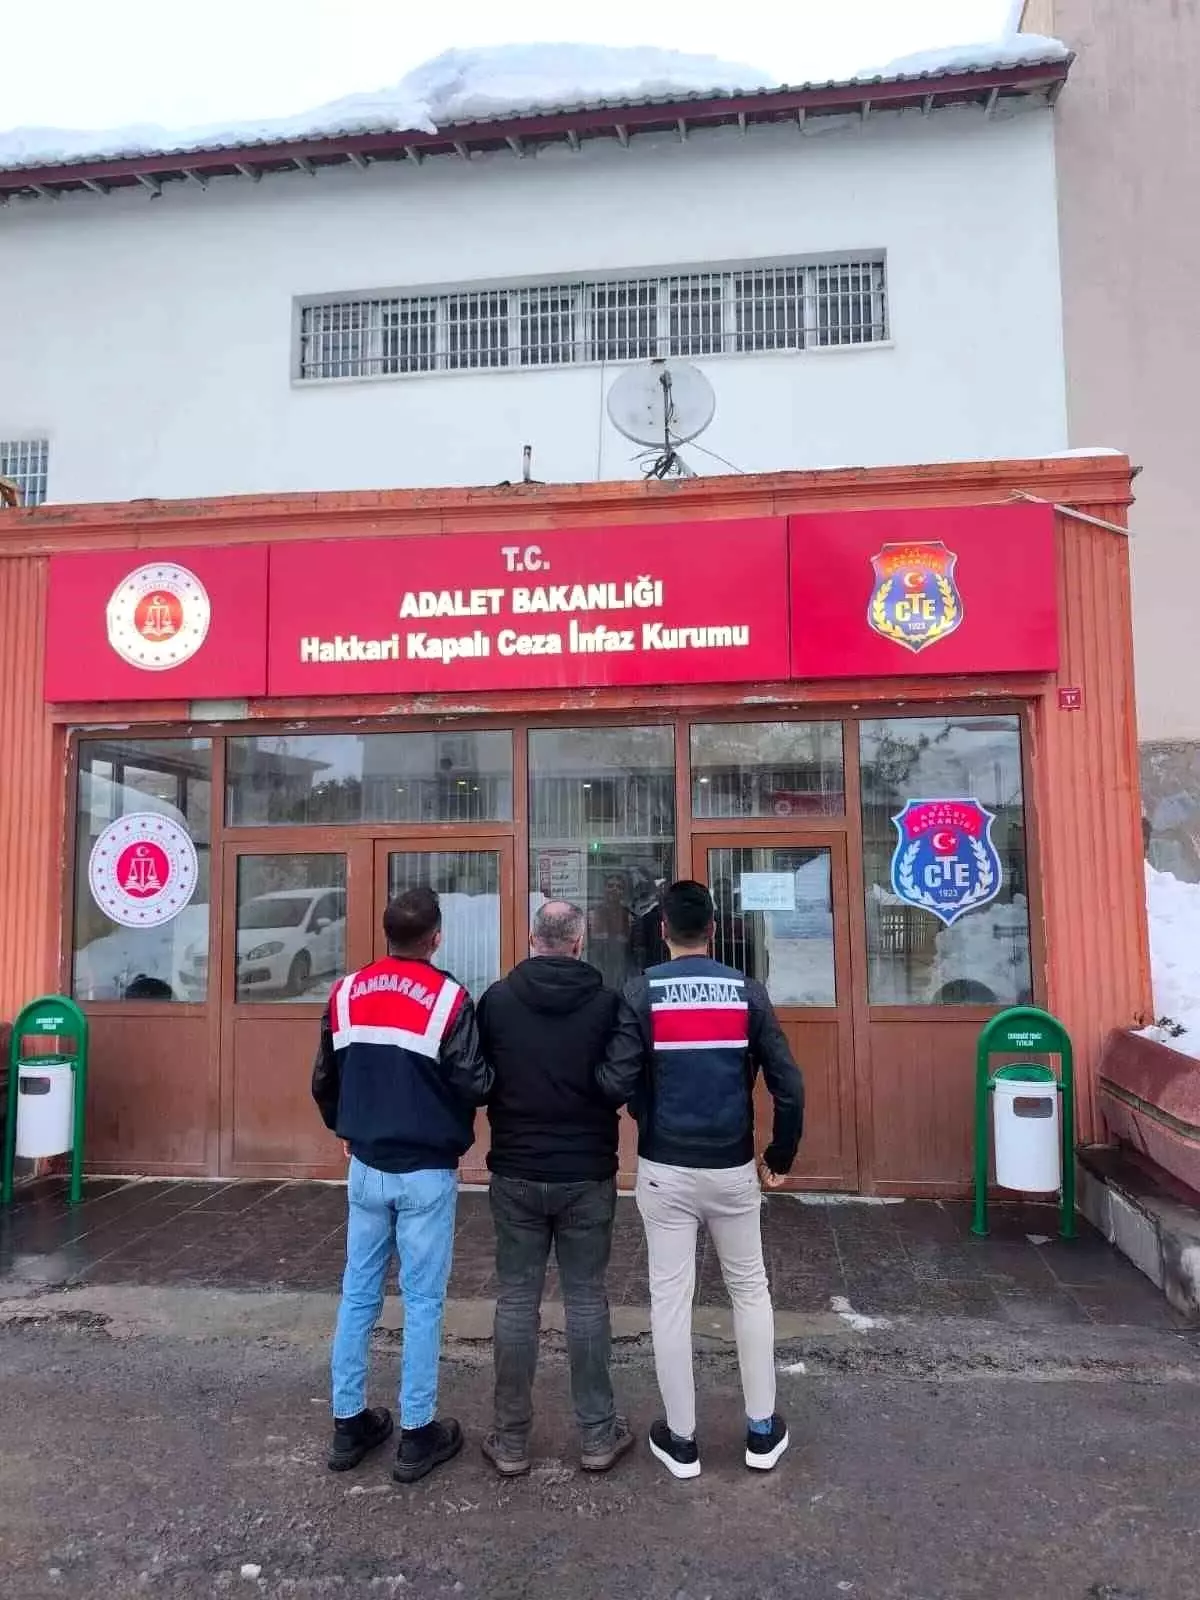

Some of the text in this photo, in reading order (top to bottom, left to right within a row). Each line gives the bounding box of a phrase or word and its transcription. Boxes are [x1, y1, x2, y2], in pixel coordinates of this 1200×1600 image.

[502, 546, 550, 572] T.C.
[399, 574, 664, 618] ADALET BAKANLIĞI
[895, 592, 937, 622] CTE
[300, 619, 750, 664] Hakkari Kapalı Ceza İnfaz Kurumu
[924, 855, 970, 888] CTE
[350, 974, 436, 1011] JANDARMA
[661, 983, 740, 1002] JANDARMA
